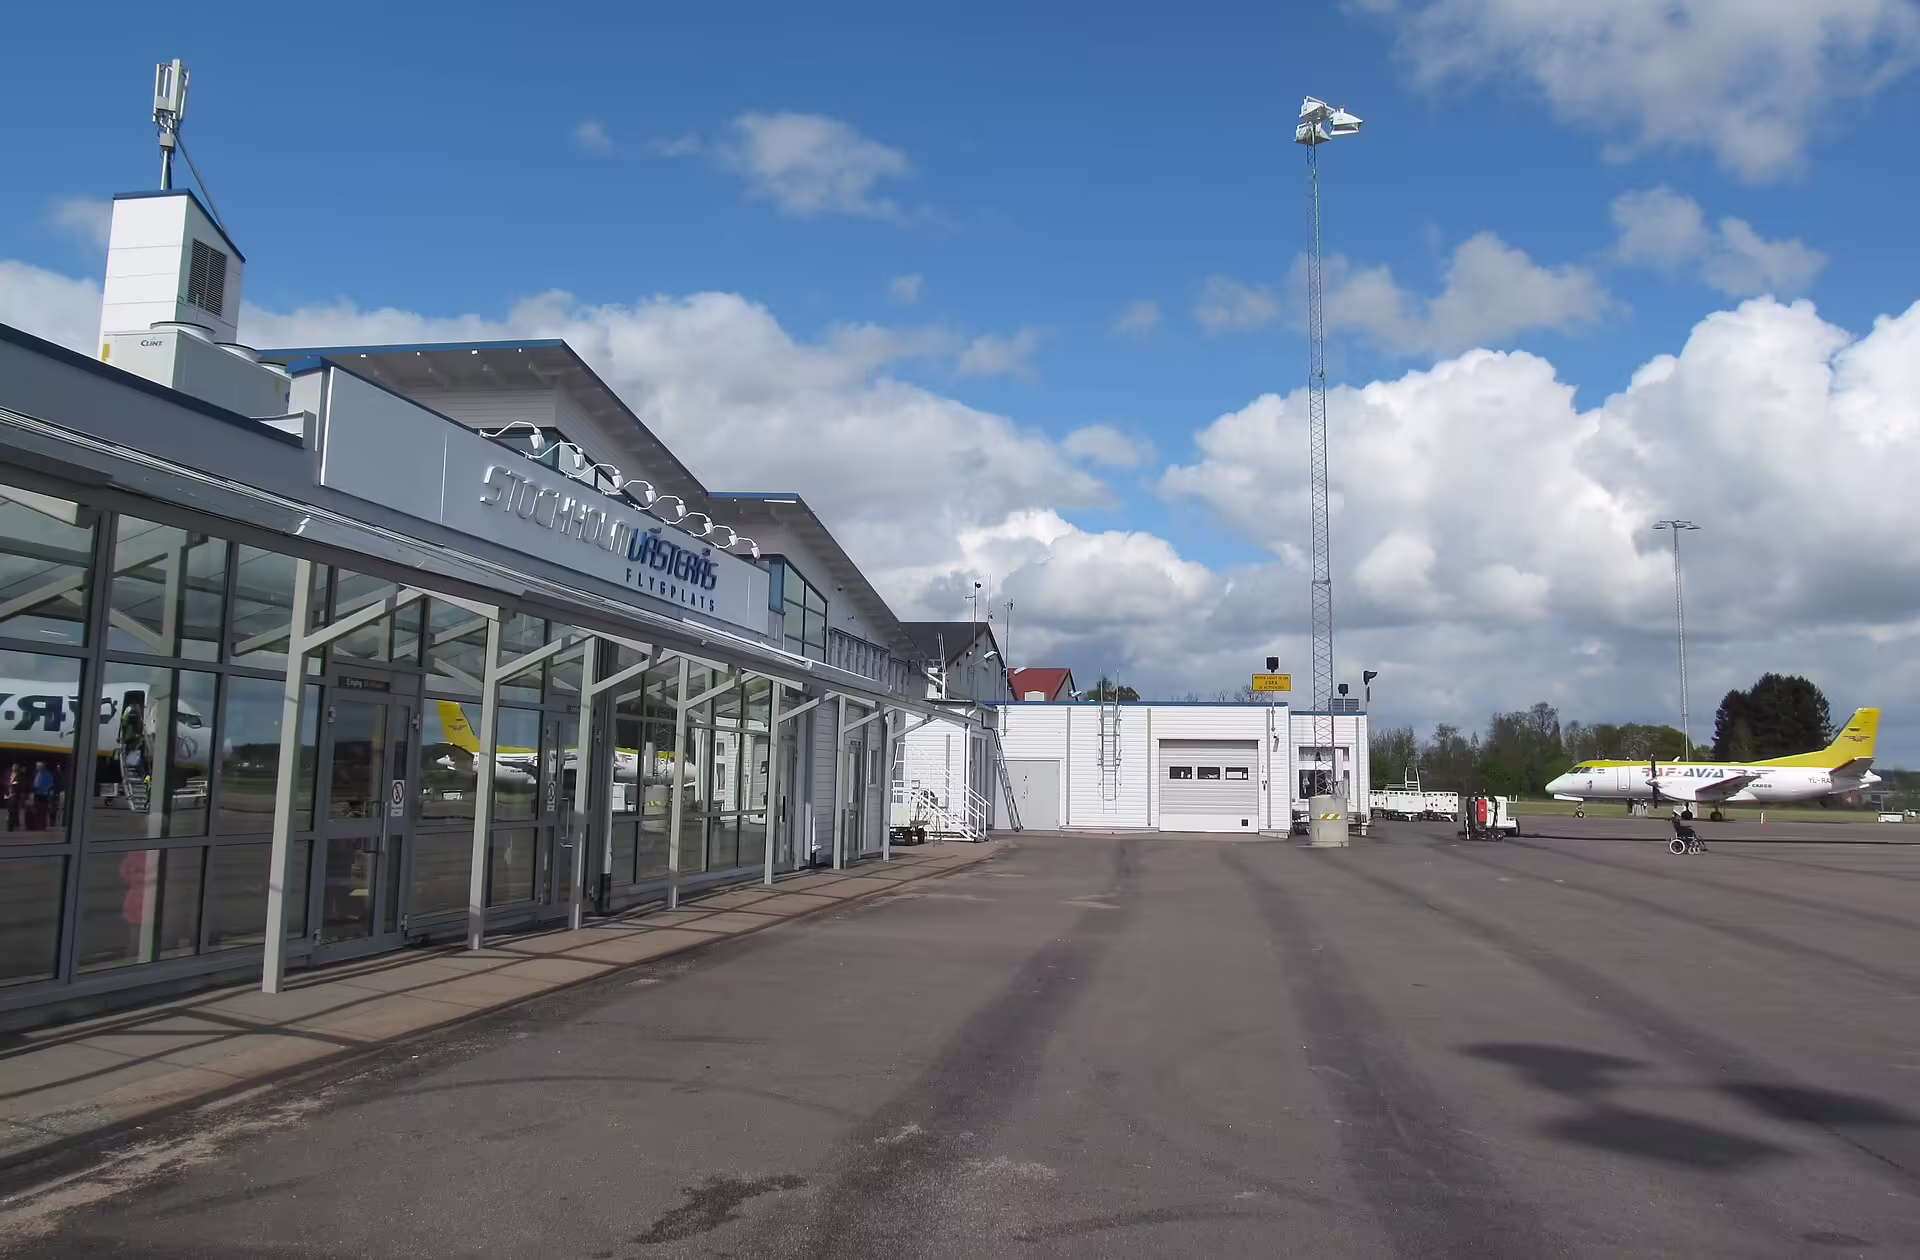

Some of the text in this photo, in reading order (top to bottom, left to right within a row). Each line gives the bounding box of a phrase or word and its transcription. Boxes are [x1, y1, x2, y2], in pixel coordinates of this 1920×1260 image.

[140, 339, 163, 347] CLINT
[479, 464, 719, 591] STOCKHOLM VÄSTERÅS
[626, 567, 715, 612] FLYGPLATS
